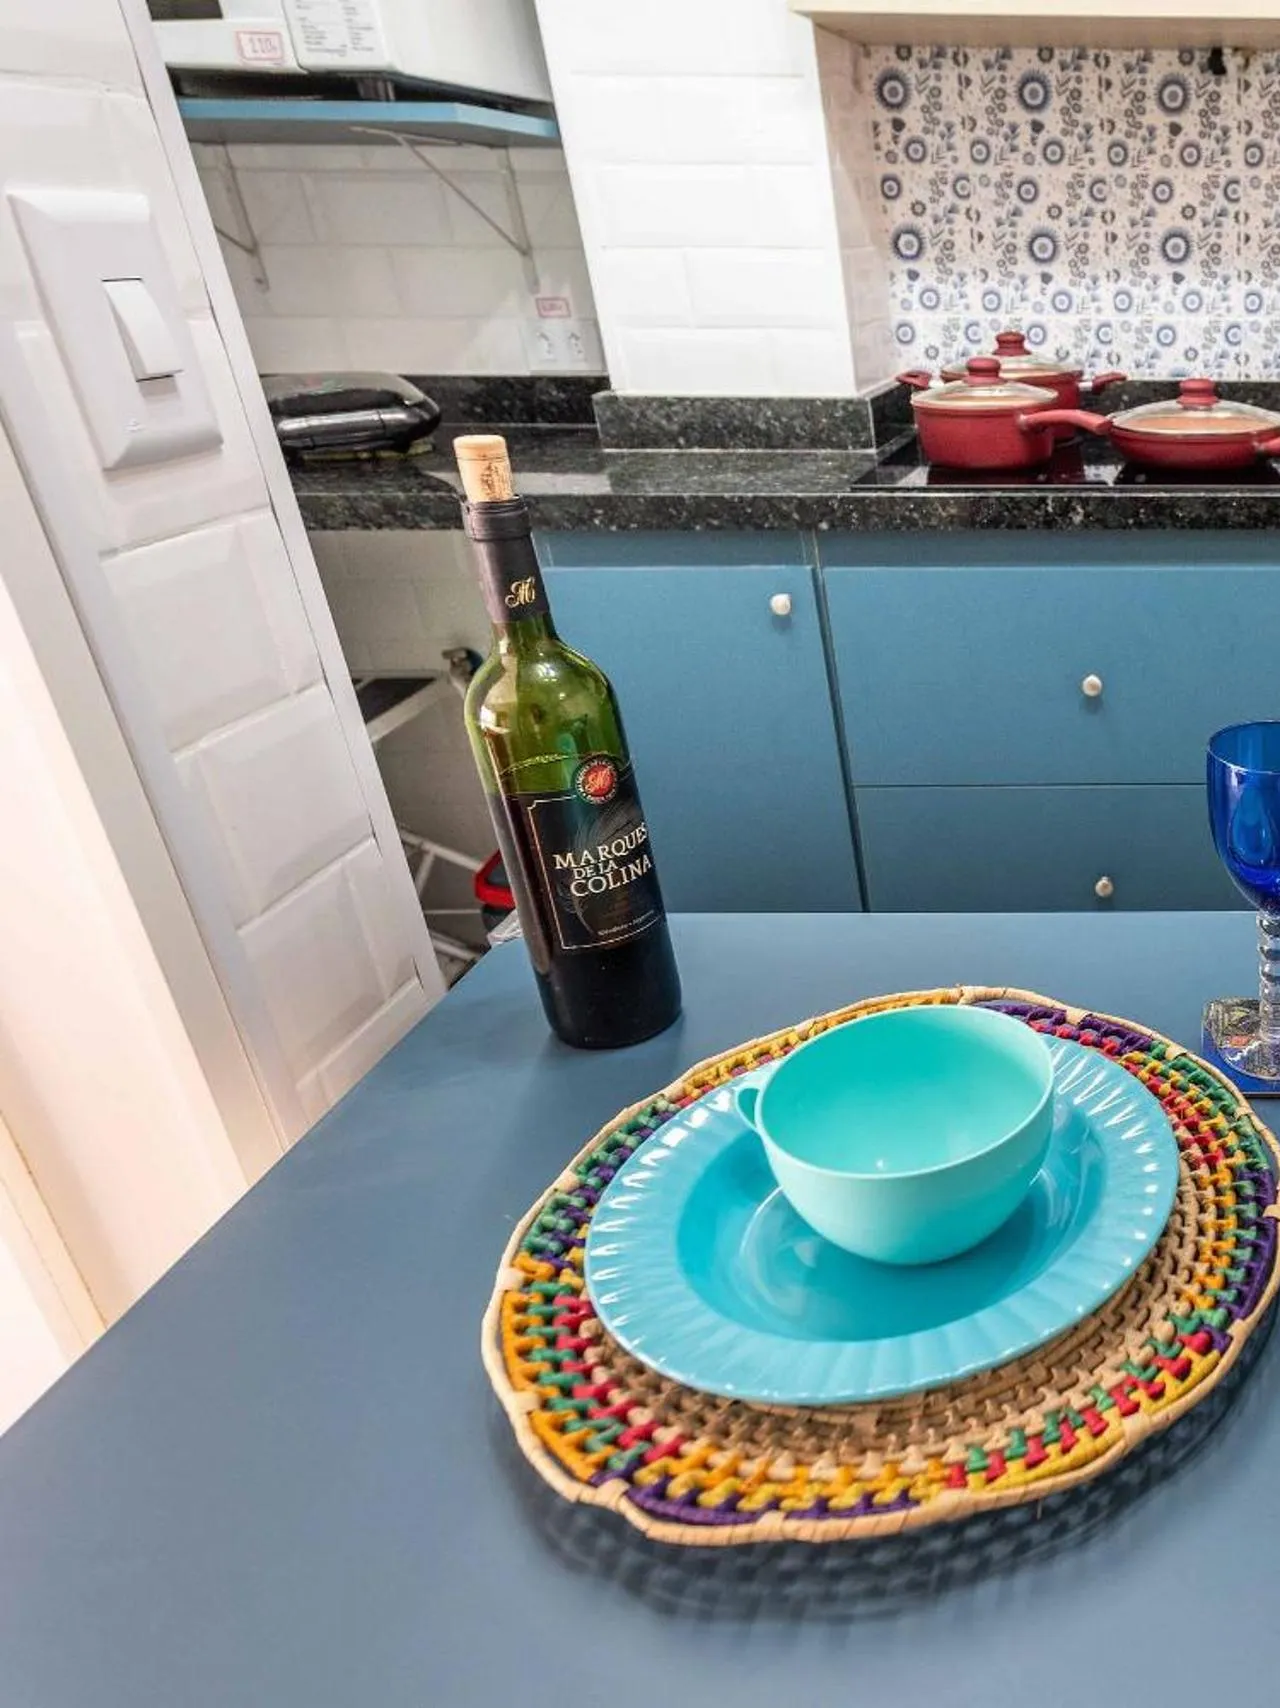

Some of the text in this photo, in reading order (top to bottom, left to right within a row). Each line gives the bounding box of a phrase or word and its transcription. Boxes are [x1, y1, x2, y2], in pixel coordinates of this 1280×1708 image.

[570, 854, 652, 897] COLINA
[573, 859, 619, 880] DE LA
